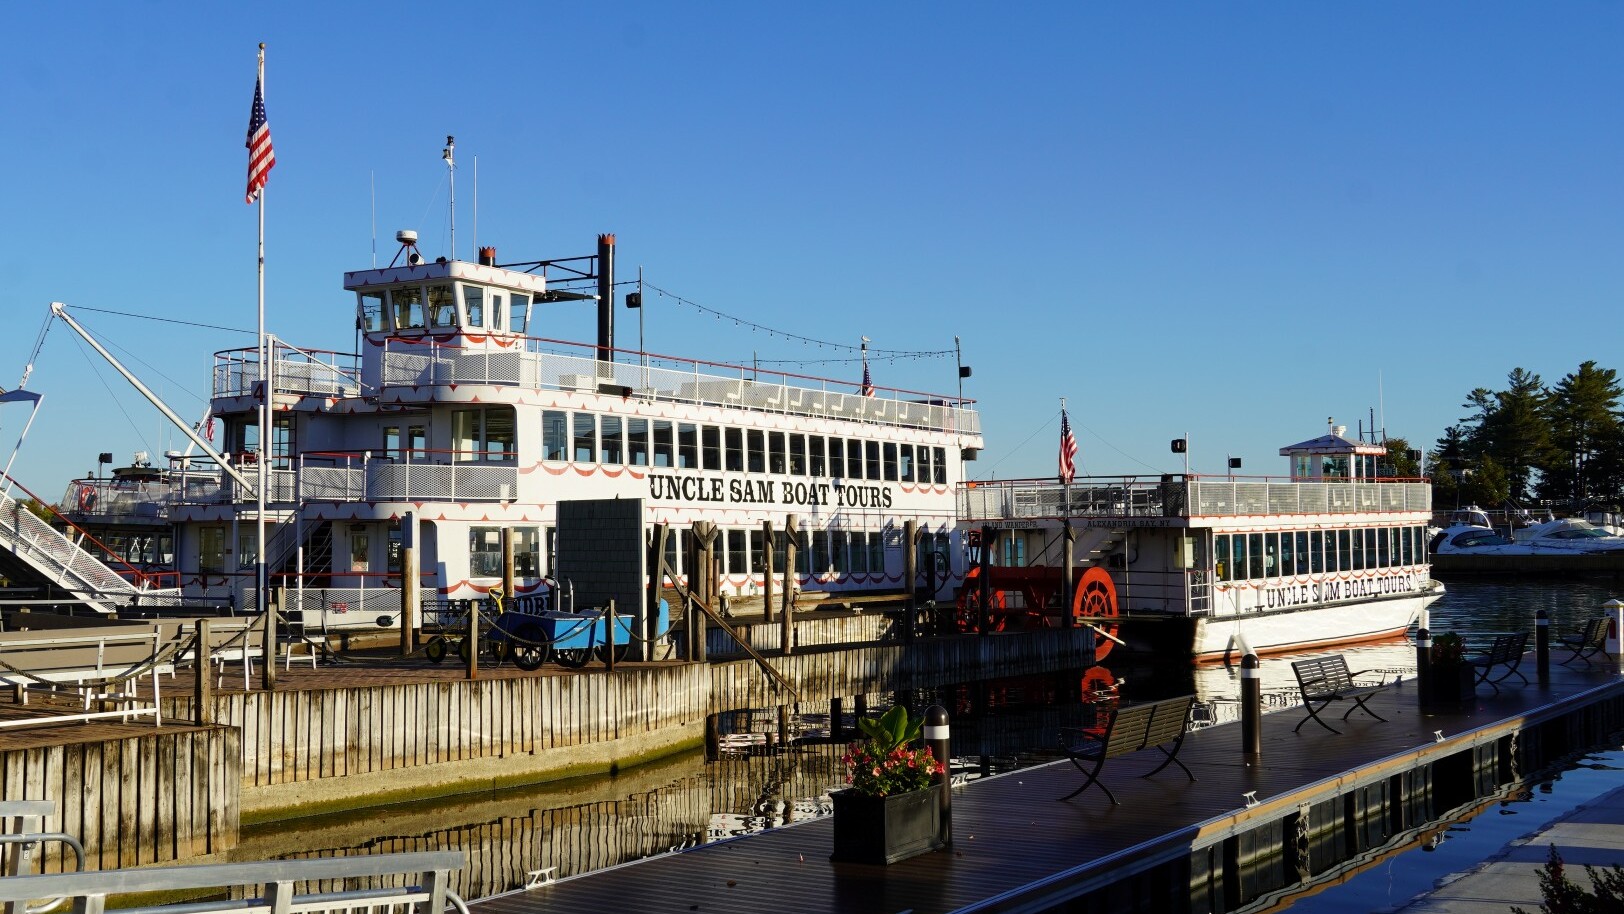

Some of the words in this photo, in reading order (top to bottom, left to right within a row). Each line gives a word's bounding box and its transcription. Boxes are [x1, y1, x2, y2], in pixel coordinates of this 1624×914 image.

[253, 383, 265, 403] 4
[648, 474, 724, 502] UNCLE
[730, 479, 775, 503] SAM
[782, 482, 830, 506] BOAT
[834, 485, 892, 508] TOURS
[1087, 520, 1136, 528] ALEXANDRIA
[1344, 578, 1373, 599] BOAT
[1377, 574, 1411, 595] TOURS
